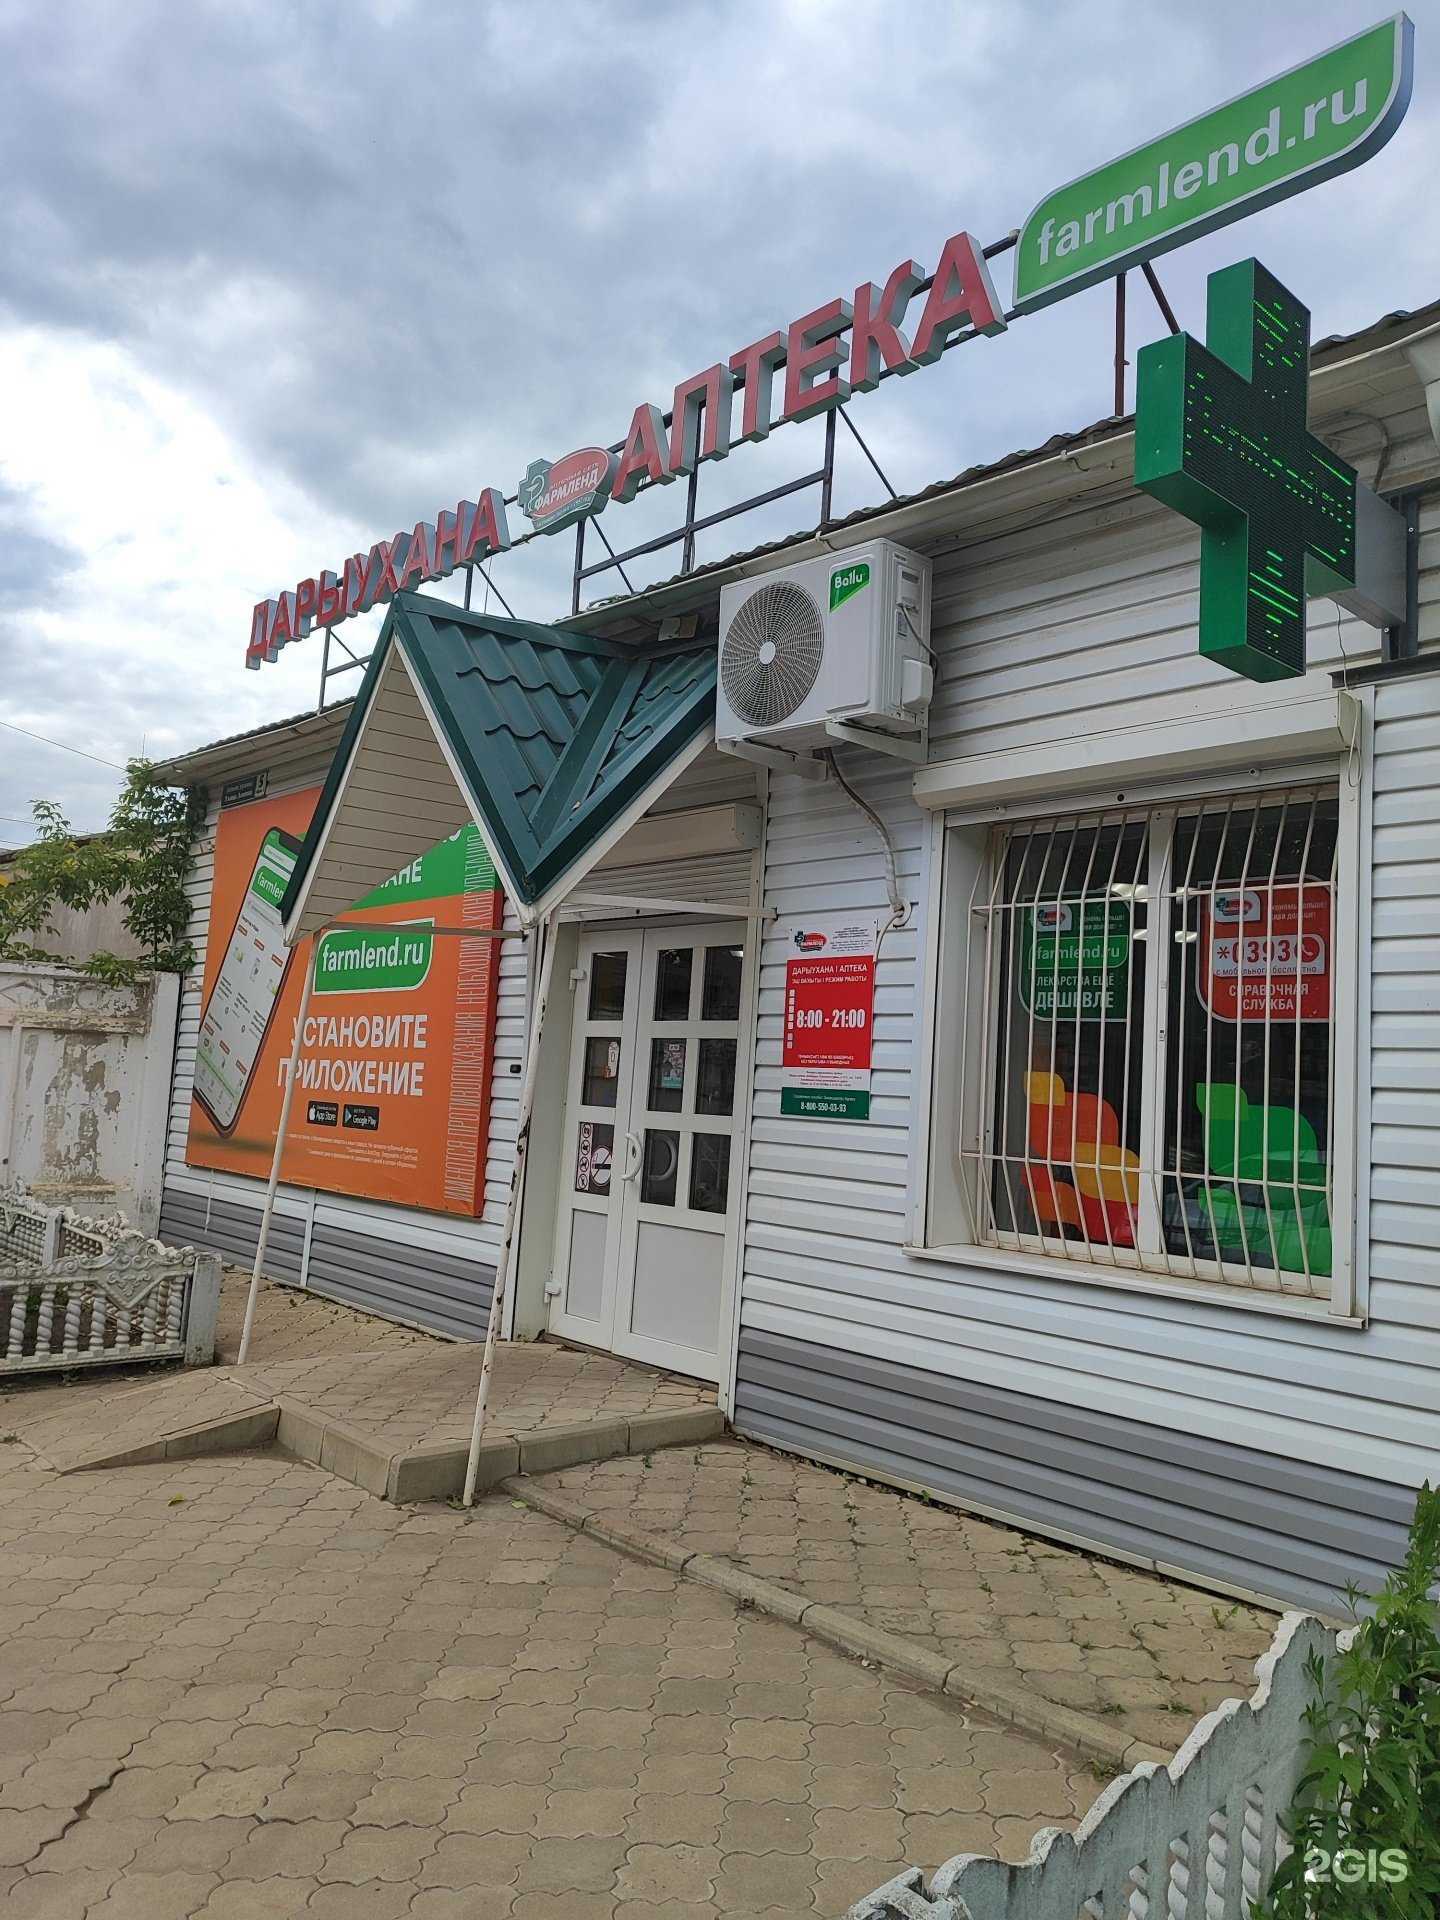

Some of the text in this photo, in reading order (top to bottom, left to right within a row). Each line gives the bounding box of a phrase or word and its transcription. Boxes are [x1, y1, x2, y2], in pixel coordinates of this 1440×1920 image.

[1037, 78, 1368, 266] farmlend.ru
[611, 231, 1007, 503] АПТЕКА
[534, 468, 600, 511] ФАРМЛЕНД
[246, 487, 510, 669] ДАРЫУХАНА
[835, 568, 863, 589] Ballu
[322, 937, 425, 972] farmlend.ru
[792, 965, 834, 976] ДАРЫУХАНА
[839, 964, 868, 973] АПТЕКА
[1222, 966, 1270, 976] мобльног
[1272, 965, 1317, 975] бесплтно
[291, 1014, 428, 1049] УСТАНОВИТЕ
[796, 1009, 823, 1029] 8:00
[832, 1008, 866, 1028] 21:00
[277, 1057, 425, 1097] ПРИЛОЖЕНИЕ
[448, 1008, 486, 1138] ПРОТИВОПОКАЗАНИЯ.
[444, 1140, 477, 1203] ИМЕЮТСЯ
